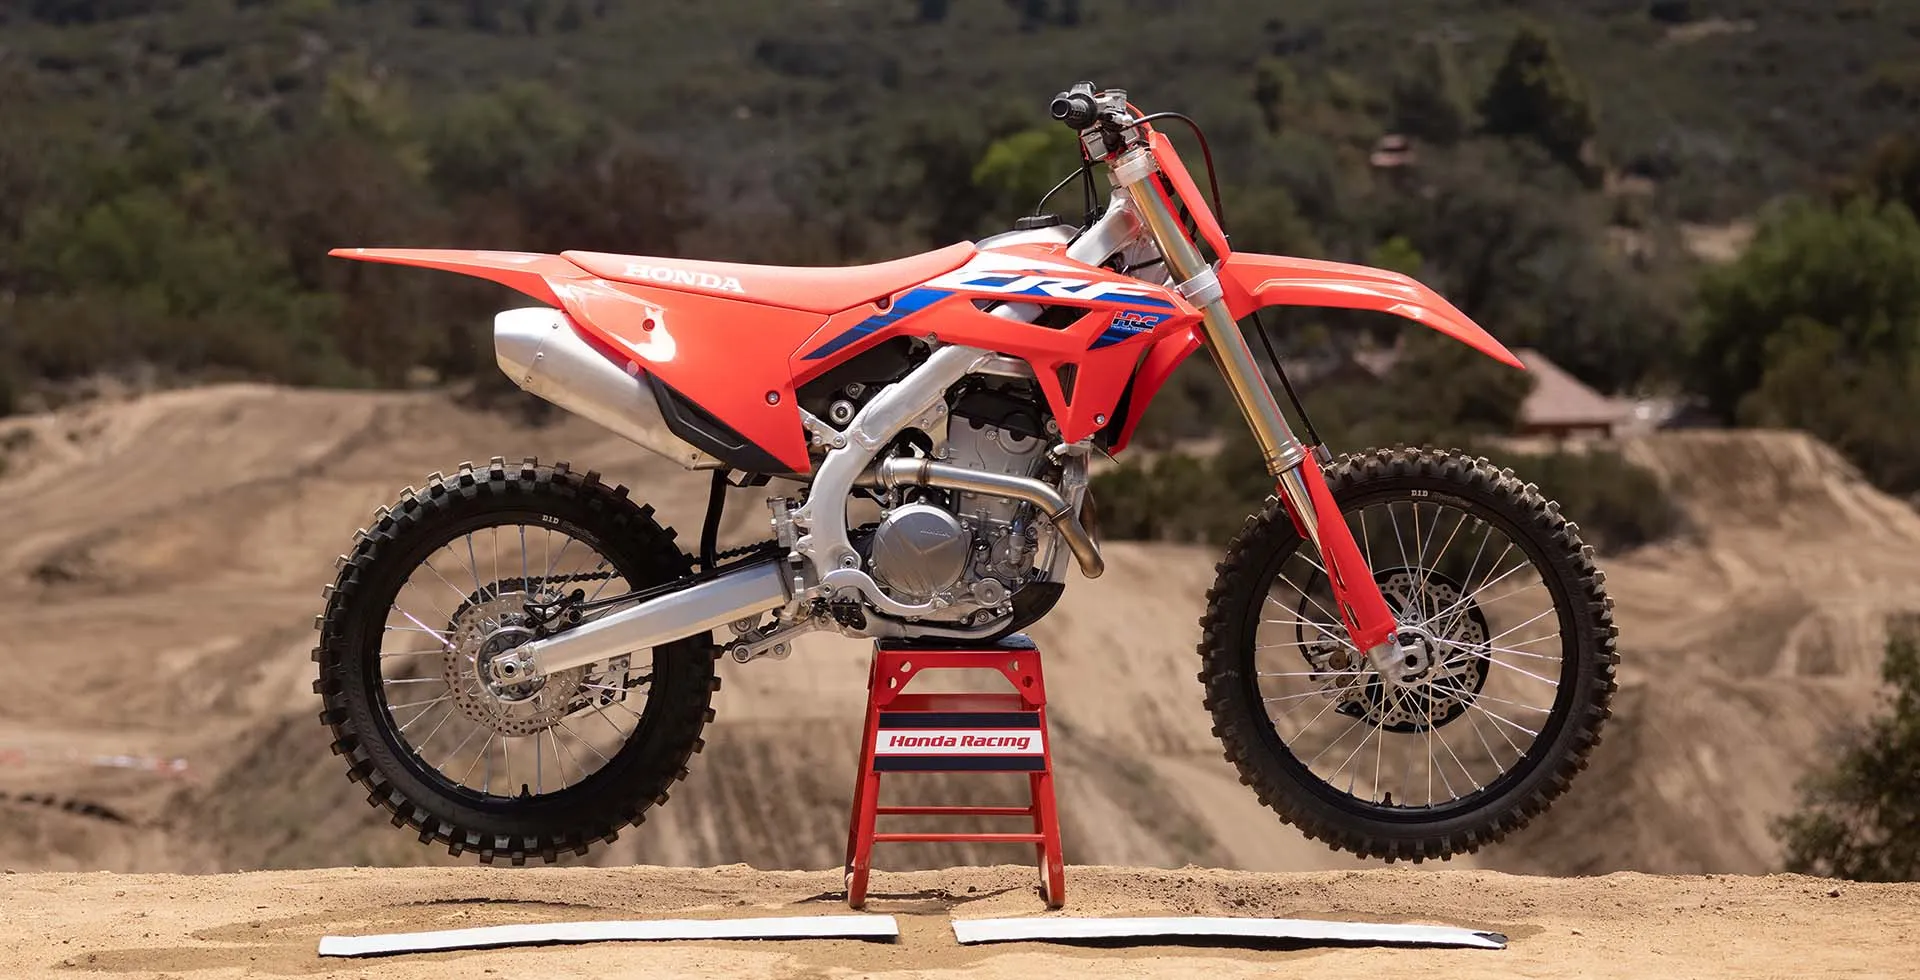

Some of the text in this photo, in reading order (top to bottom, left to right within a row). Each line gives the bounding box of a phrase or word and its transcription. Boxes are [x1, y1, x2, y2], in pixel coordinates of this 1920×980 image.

[623, 262, 745, 294] HONDA
[942, 269, 1158, 300] CRF
[1111, 311, 1159, 329] HRC
[889, 735, 1031, 750] Honda Racing
